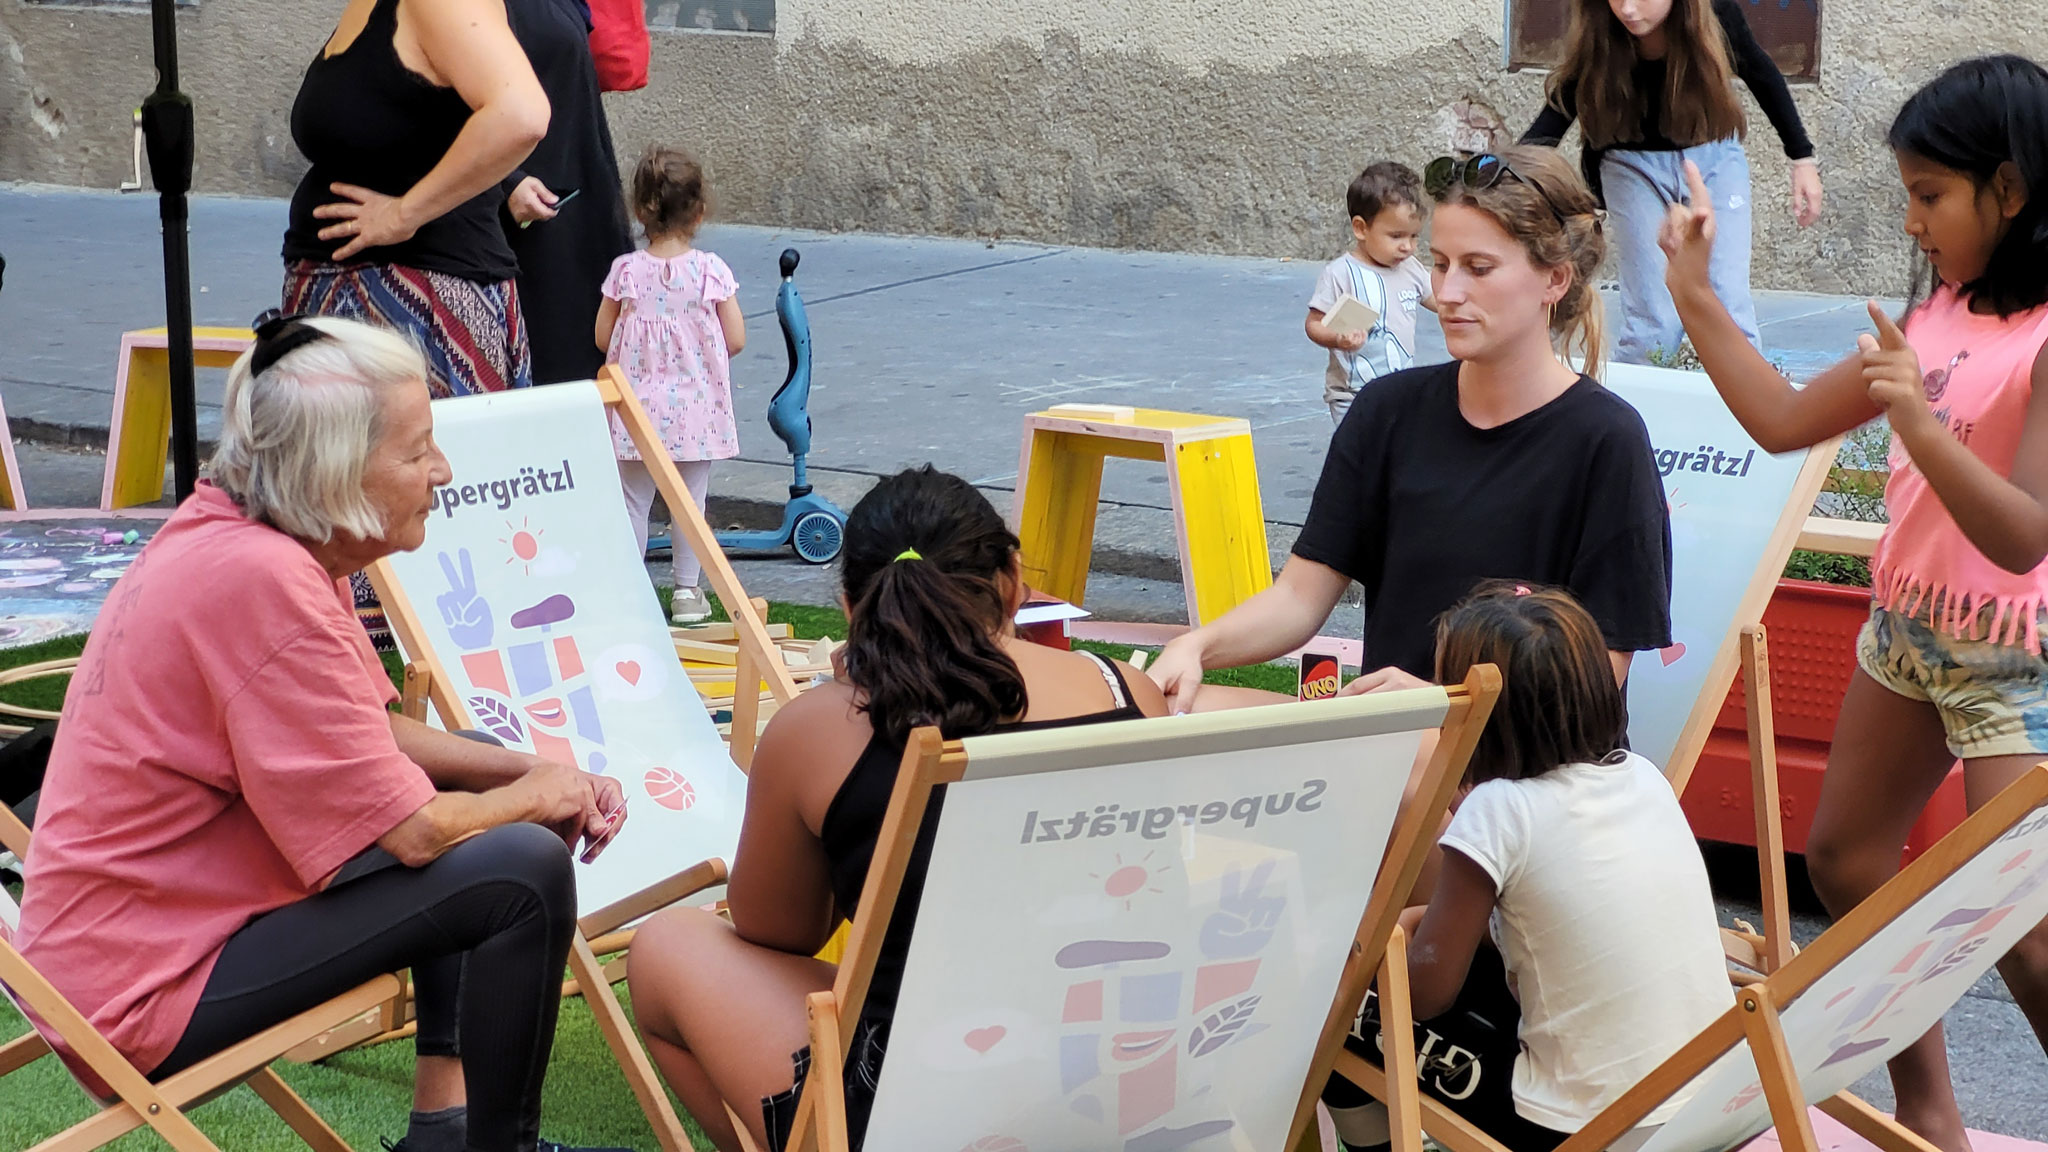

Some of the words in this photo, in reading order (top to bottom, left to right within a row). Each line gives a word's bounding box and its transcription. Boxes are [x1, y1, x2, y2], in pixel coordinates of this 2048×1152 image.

[1653, 445, 1755, 477] grätzl
[429, 459, 575, 518] upergrätzl
[1301, 675, 1337, 700] UNO
